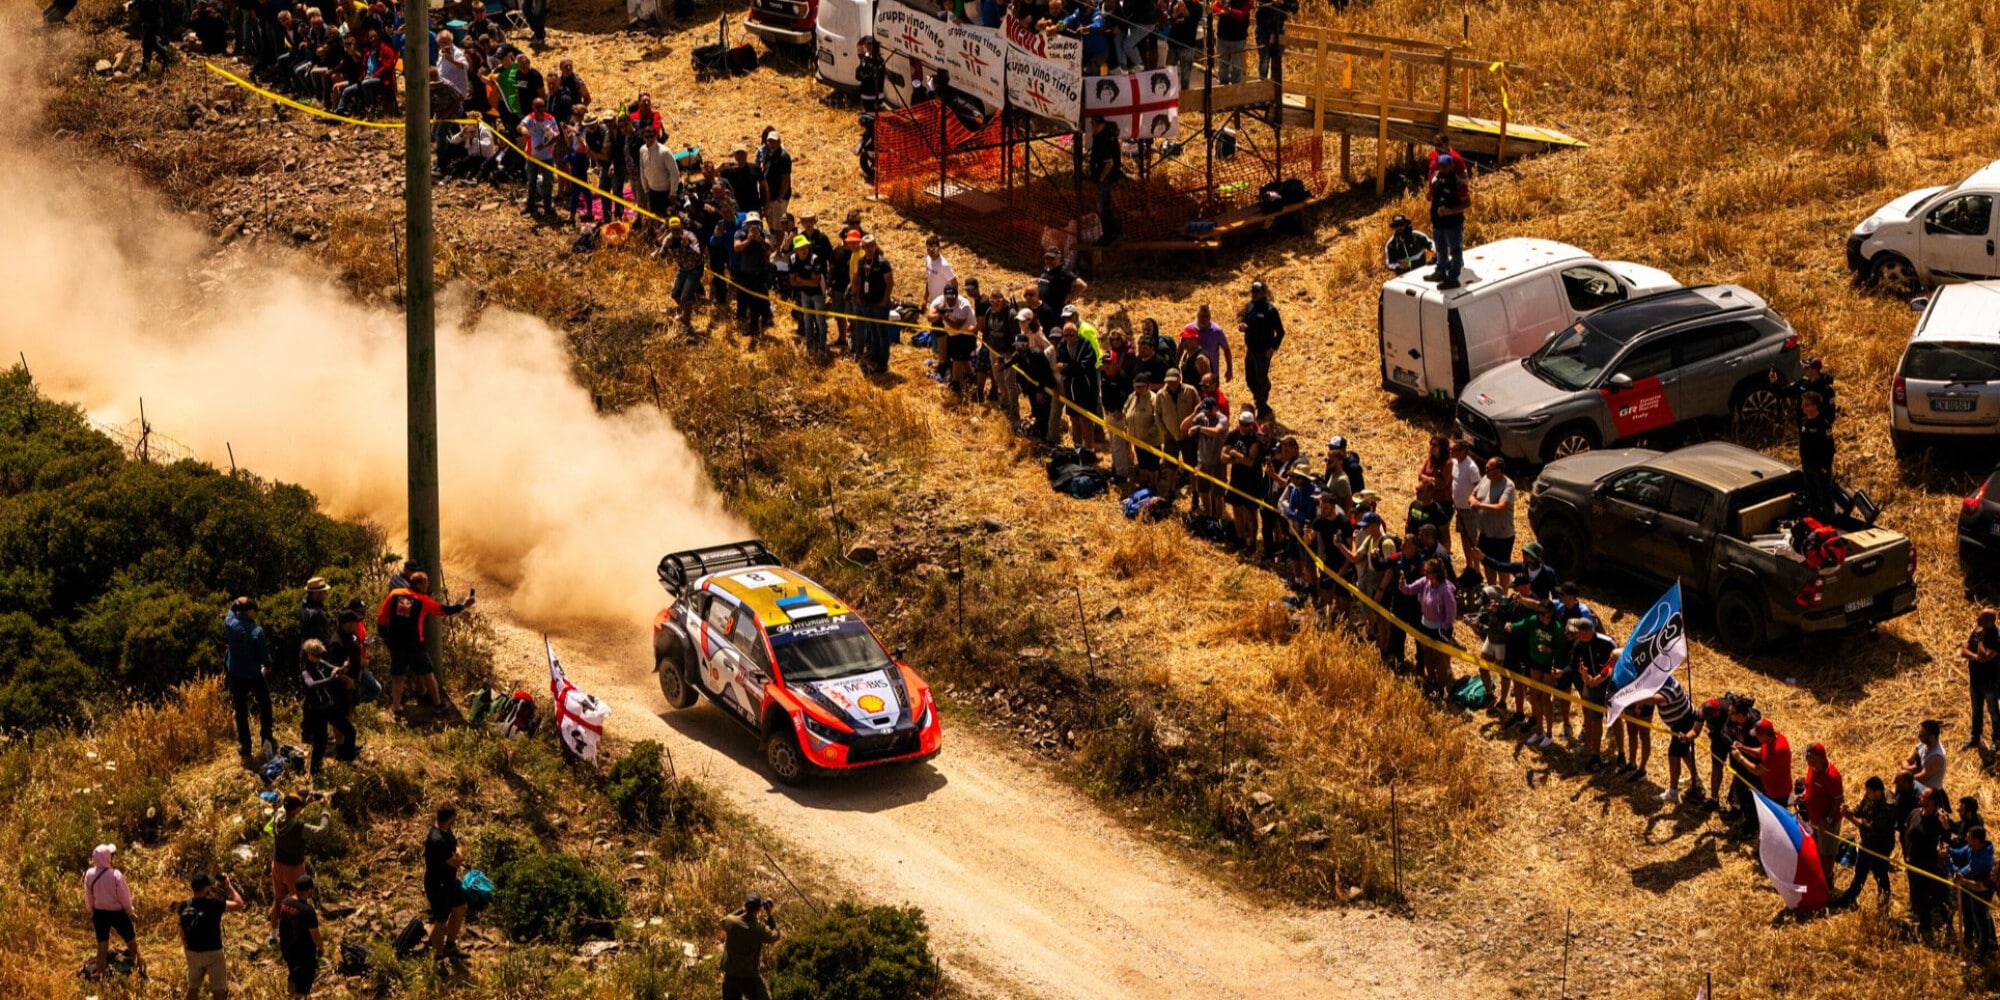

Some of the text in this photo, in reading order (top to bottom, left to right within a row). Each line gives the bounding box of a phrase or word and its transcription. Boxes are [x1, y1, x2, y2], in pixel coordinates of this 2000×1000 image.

[906, 13, 925, 30] vino
[1032, 65, 1050, 82] vino
[1632, 412, 1648, 420] Italy
[793, 617, 830, 629] HYUNDAI
[843, 679, 888, 693] MOBIS
